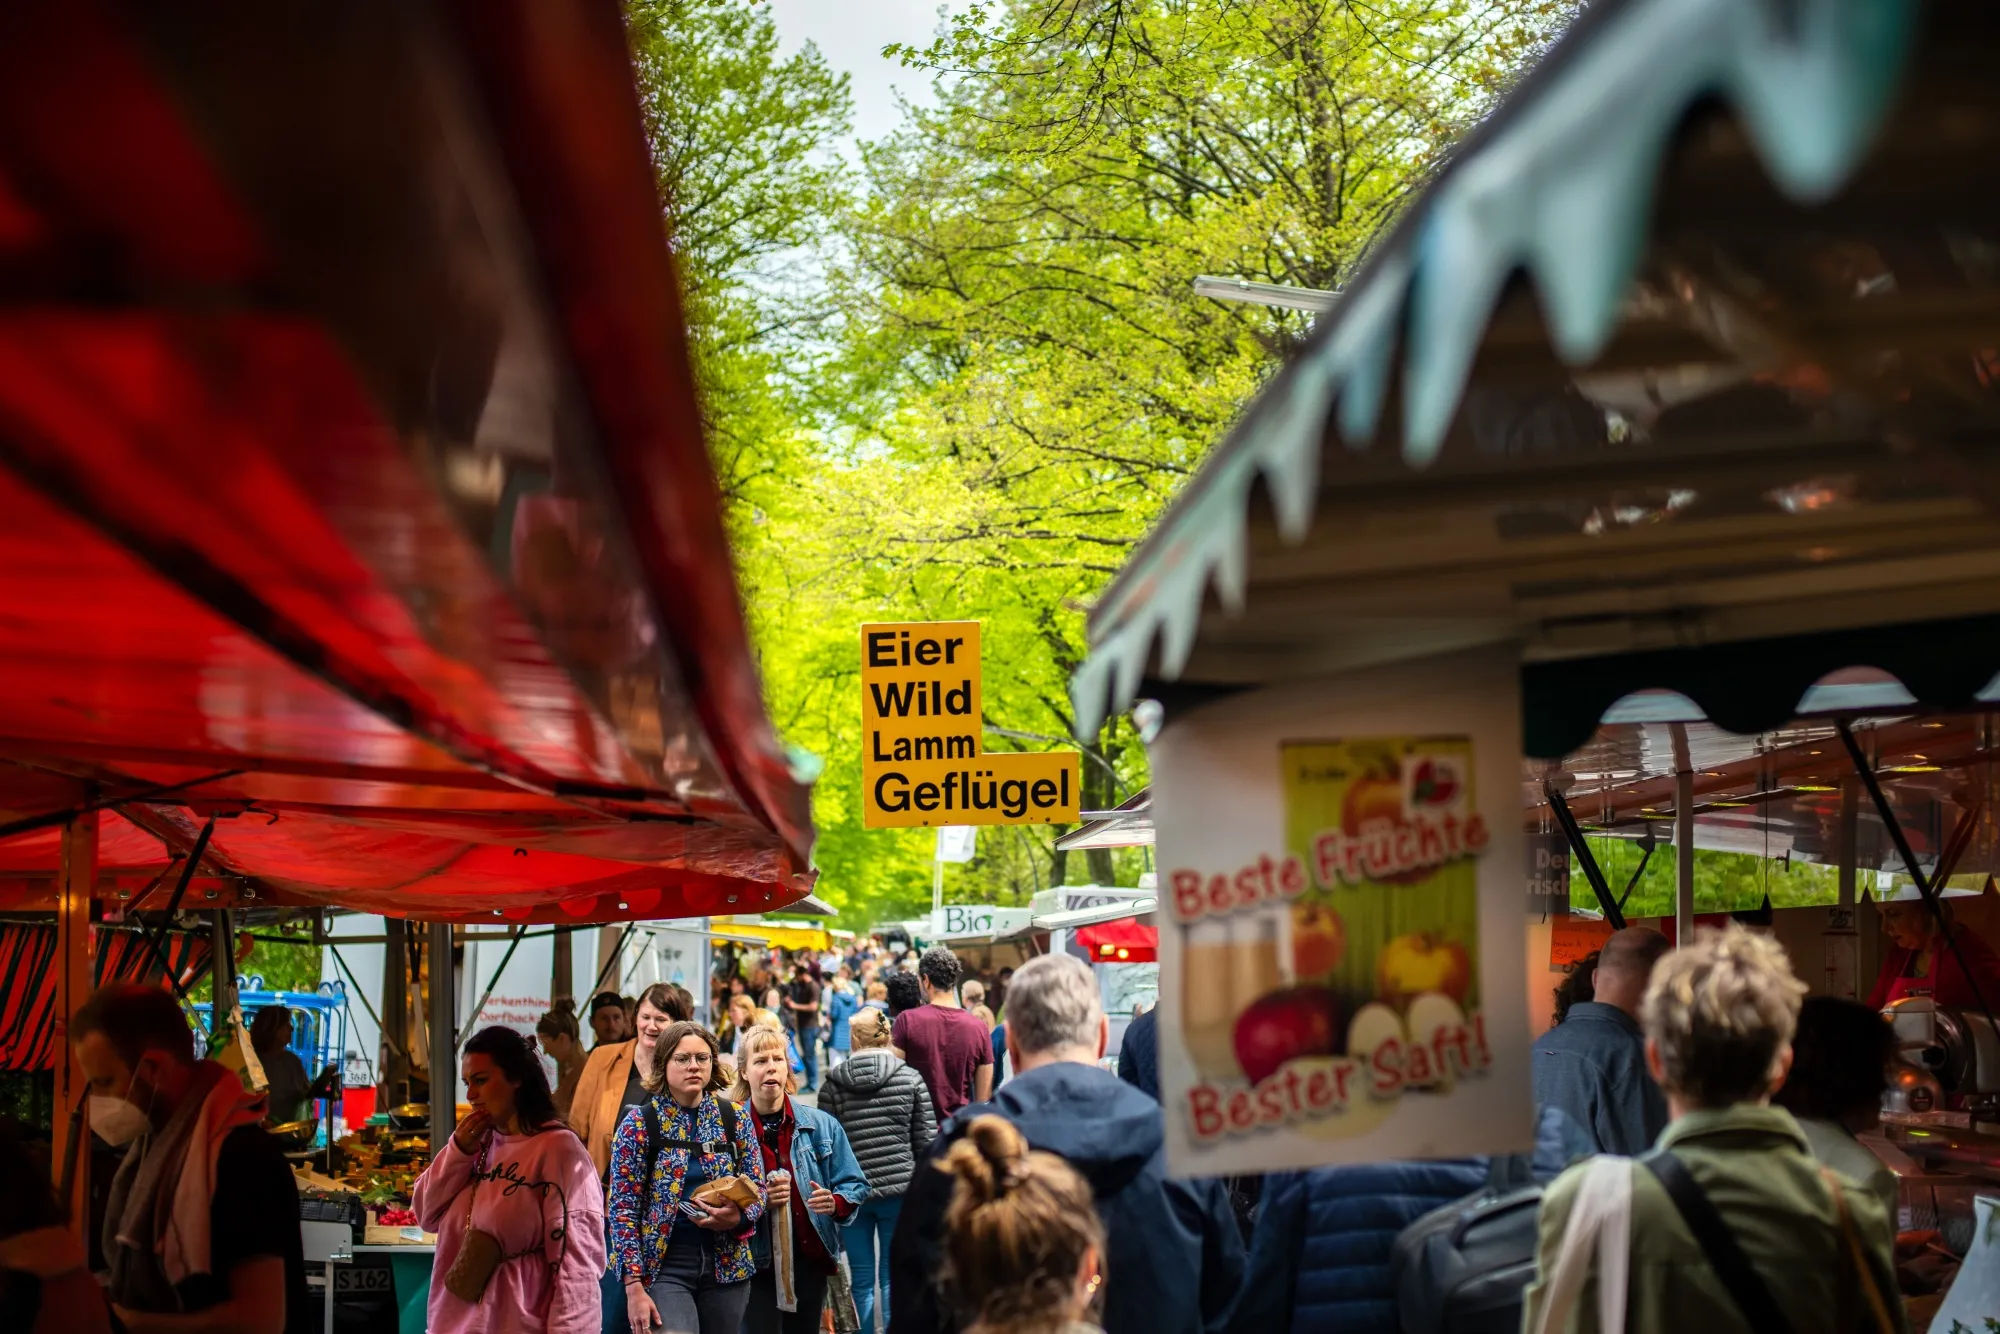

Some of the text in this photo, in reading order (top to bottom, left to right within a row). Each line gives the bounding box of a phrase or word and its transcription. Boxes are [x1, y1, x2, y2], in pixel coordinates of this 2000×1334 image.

[868, 631, 963, 667] Eier
[870, 680, 971, 717] Wild
[873, 731, 975, 762] Lamm
[874, 768, 1069, 818] Geflügel
[1170, 812, 1490, 918] Beste Früchte
[945, 907, 993, 933] Bio
[1188, 1014, 1494, 1137] Bester Saft!
[354, 1270, 388, 1289] 162
